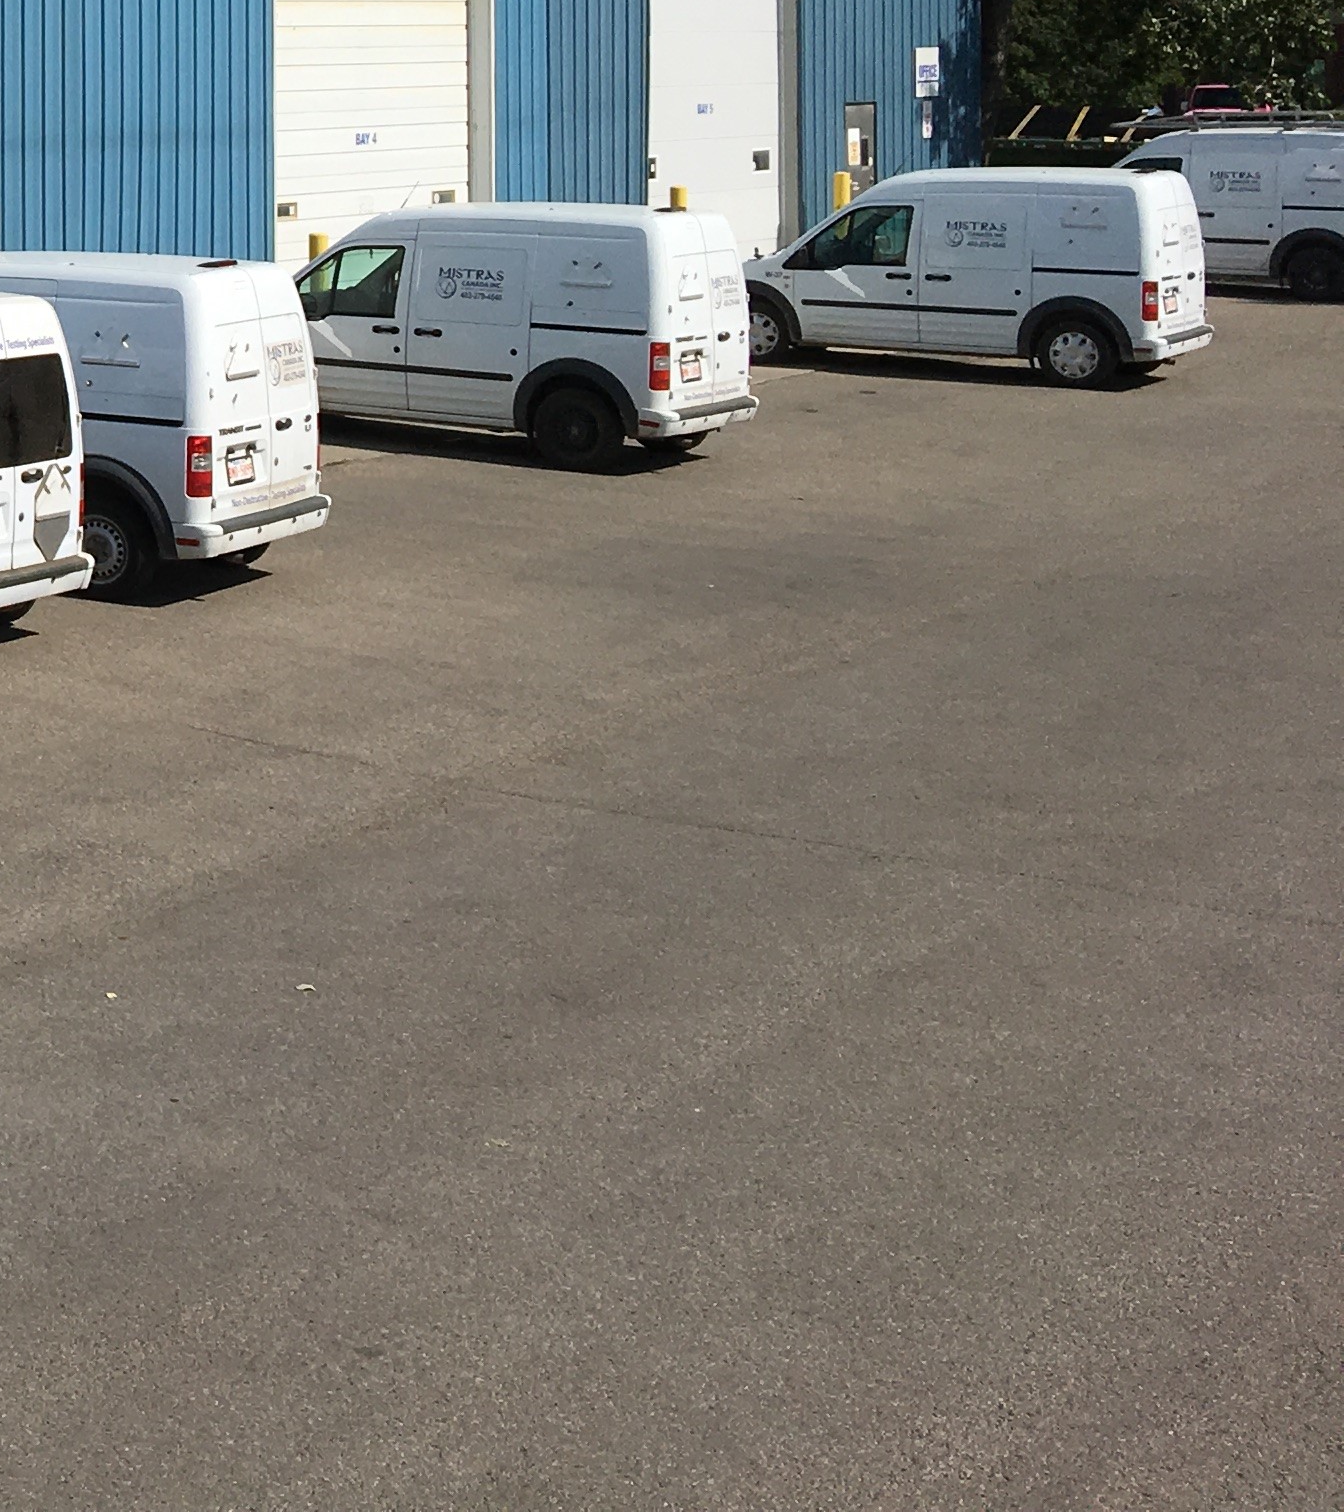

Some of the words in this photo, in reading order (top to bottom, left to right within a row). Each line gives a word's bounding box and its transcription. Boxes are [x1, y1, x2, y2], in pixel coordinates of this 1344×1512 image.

[355, 133, 370, 145] BAY
[372, 132, 377, 144] 4
[1210, 171, 1261, 179] MISTRAS
[946, 221, 1007, 232] MISTRAS
[439, 267, 504, 281] MISTRAS
[6, 339, 27, 350] Testing
[27, 336, 54, 348] Specialists
[267, 340, 303, 358] MISTRAS
